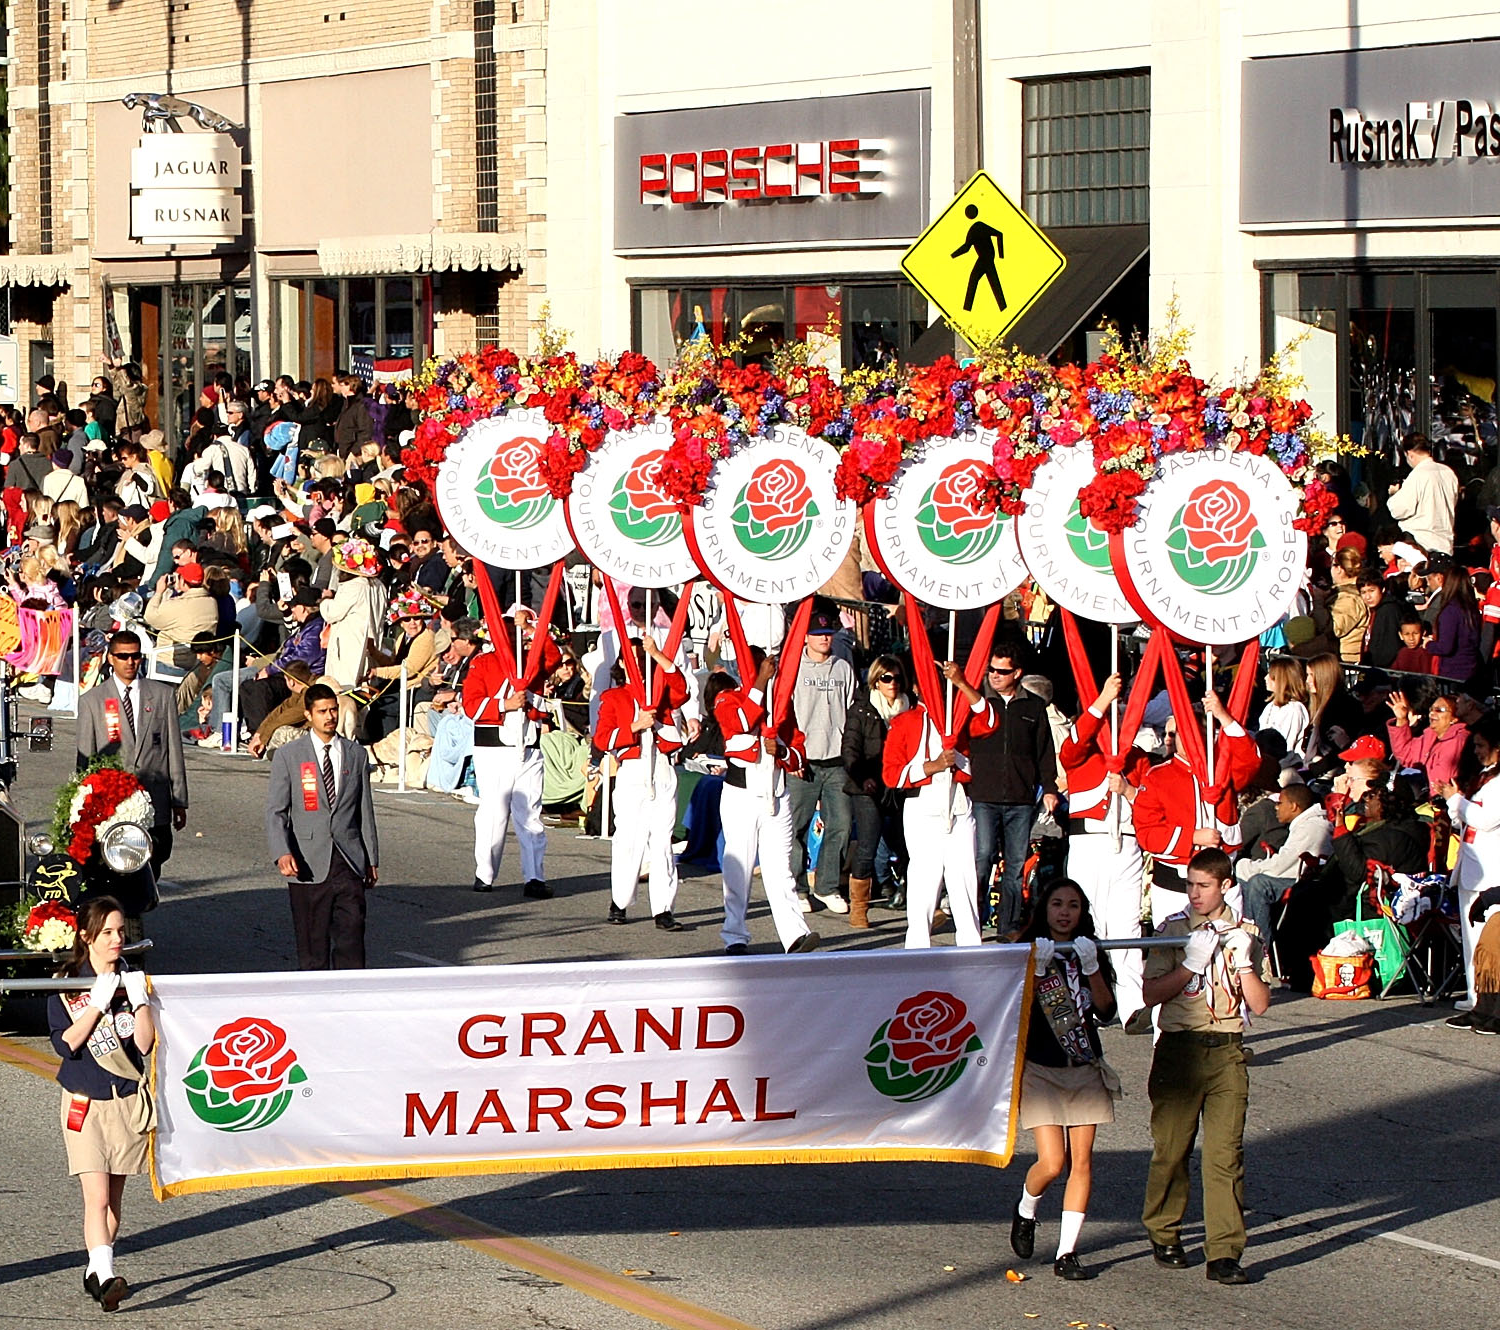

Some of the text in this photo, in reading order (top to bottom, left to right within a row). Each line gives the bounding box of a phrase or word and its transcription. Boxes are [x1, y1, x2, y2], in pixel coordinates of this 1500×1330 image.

[1330, 103, 1419, 163] Rusnak
[154, 161, 229, 178] JAGUAR
[640, 139, 861, 204] PORSCHE
[155, 208, 230, 222] RUSNAK
[1155, 448, 1272, 489] PASADENA
[578, 470, 676, 579] TOURNAMENT
[1133, 503, 1298, 633] TOURNAMENT of ROSES
[44, 890, 62, 899] FTD
[1040, 978, 1060, 993] 2010
[457, 1004, 745, 1060] GRAND
[404, 1076, 797, 1138] MARSHAL
